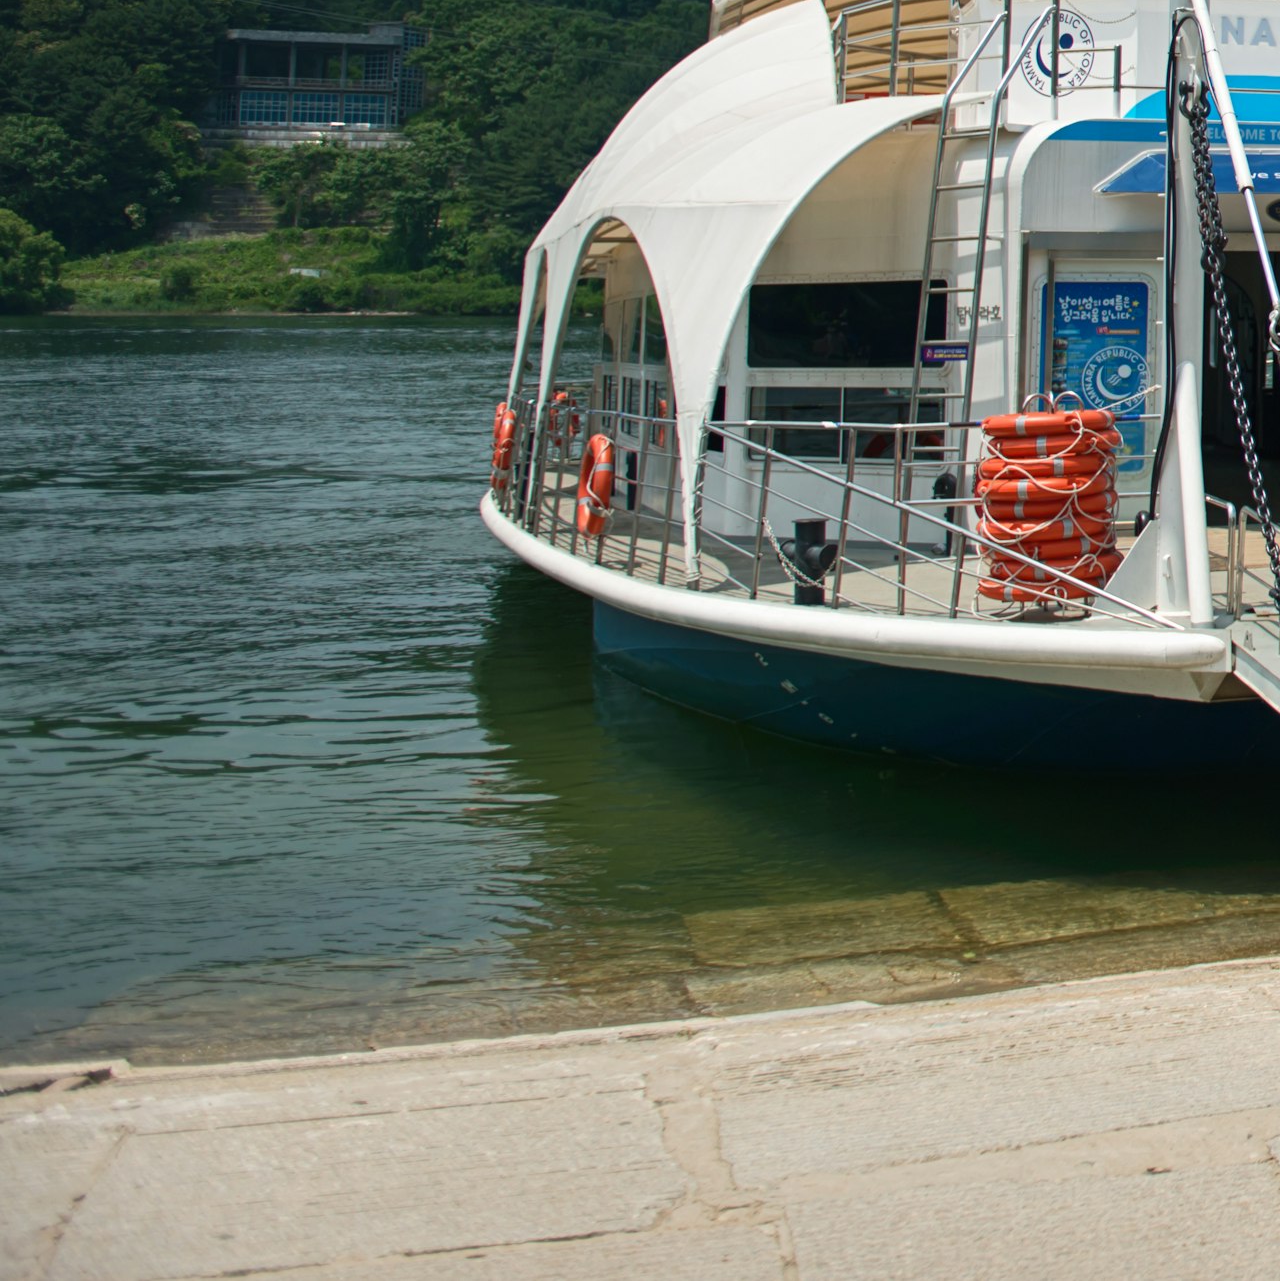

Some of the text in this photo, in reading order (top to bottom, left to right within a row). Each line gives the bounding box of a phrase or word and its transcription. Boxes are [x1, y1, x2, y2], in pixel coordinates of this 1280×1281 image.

[1079, 29, 1091, 46] OF
[956, 304, 1002, 326] 탐라호
[1096, 349, 1139, 364] REPUBLIC
